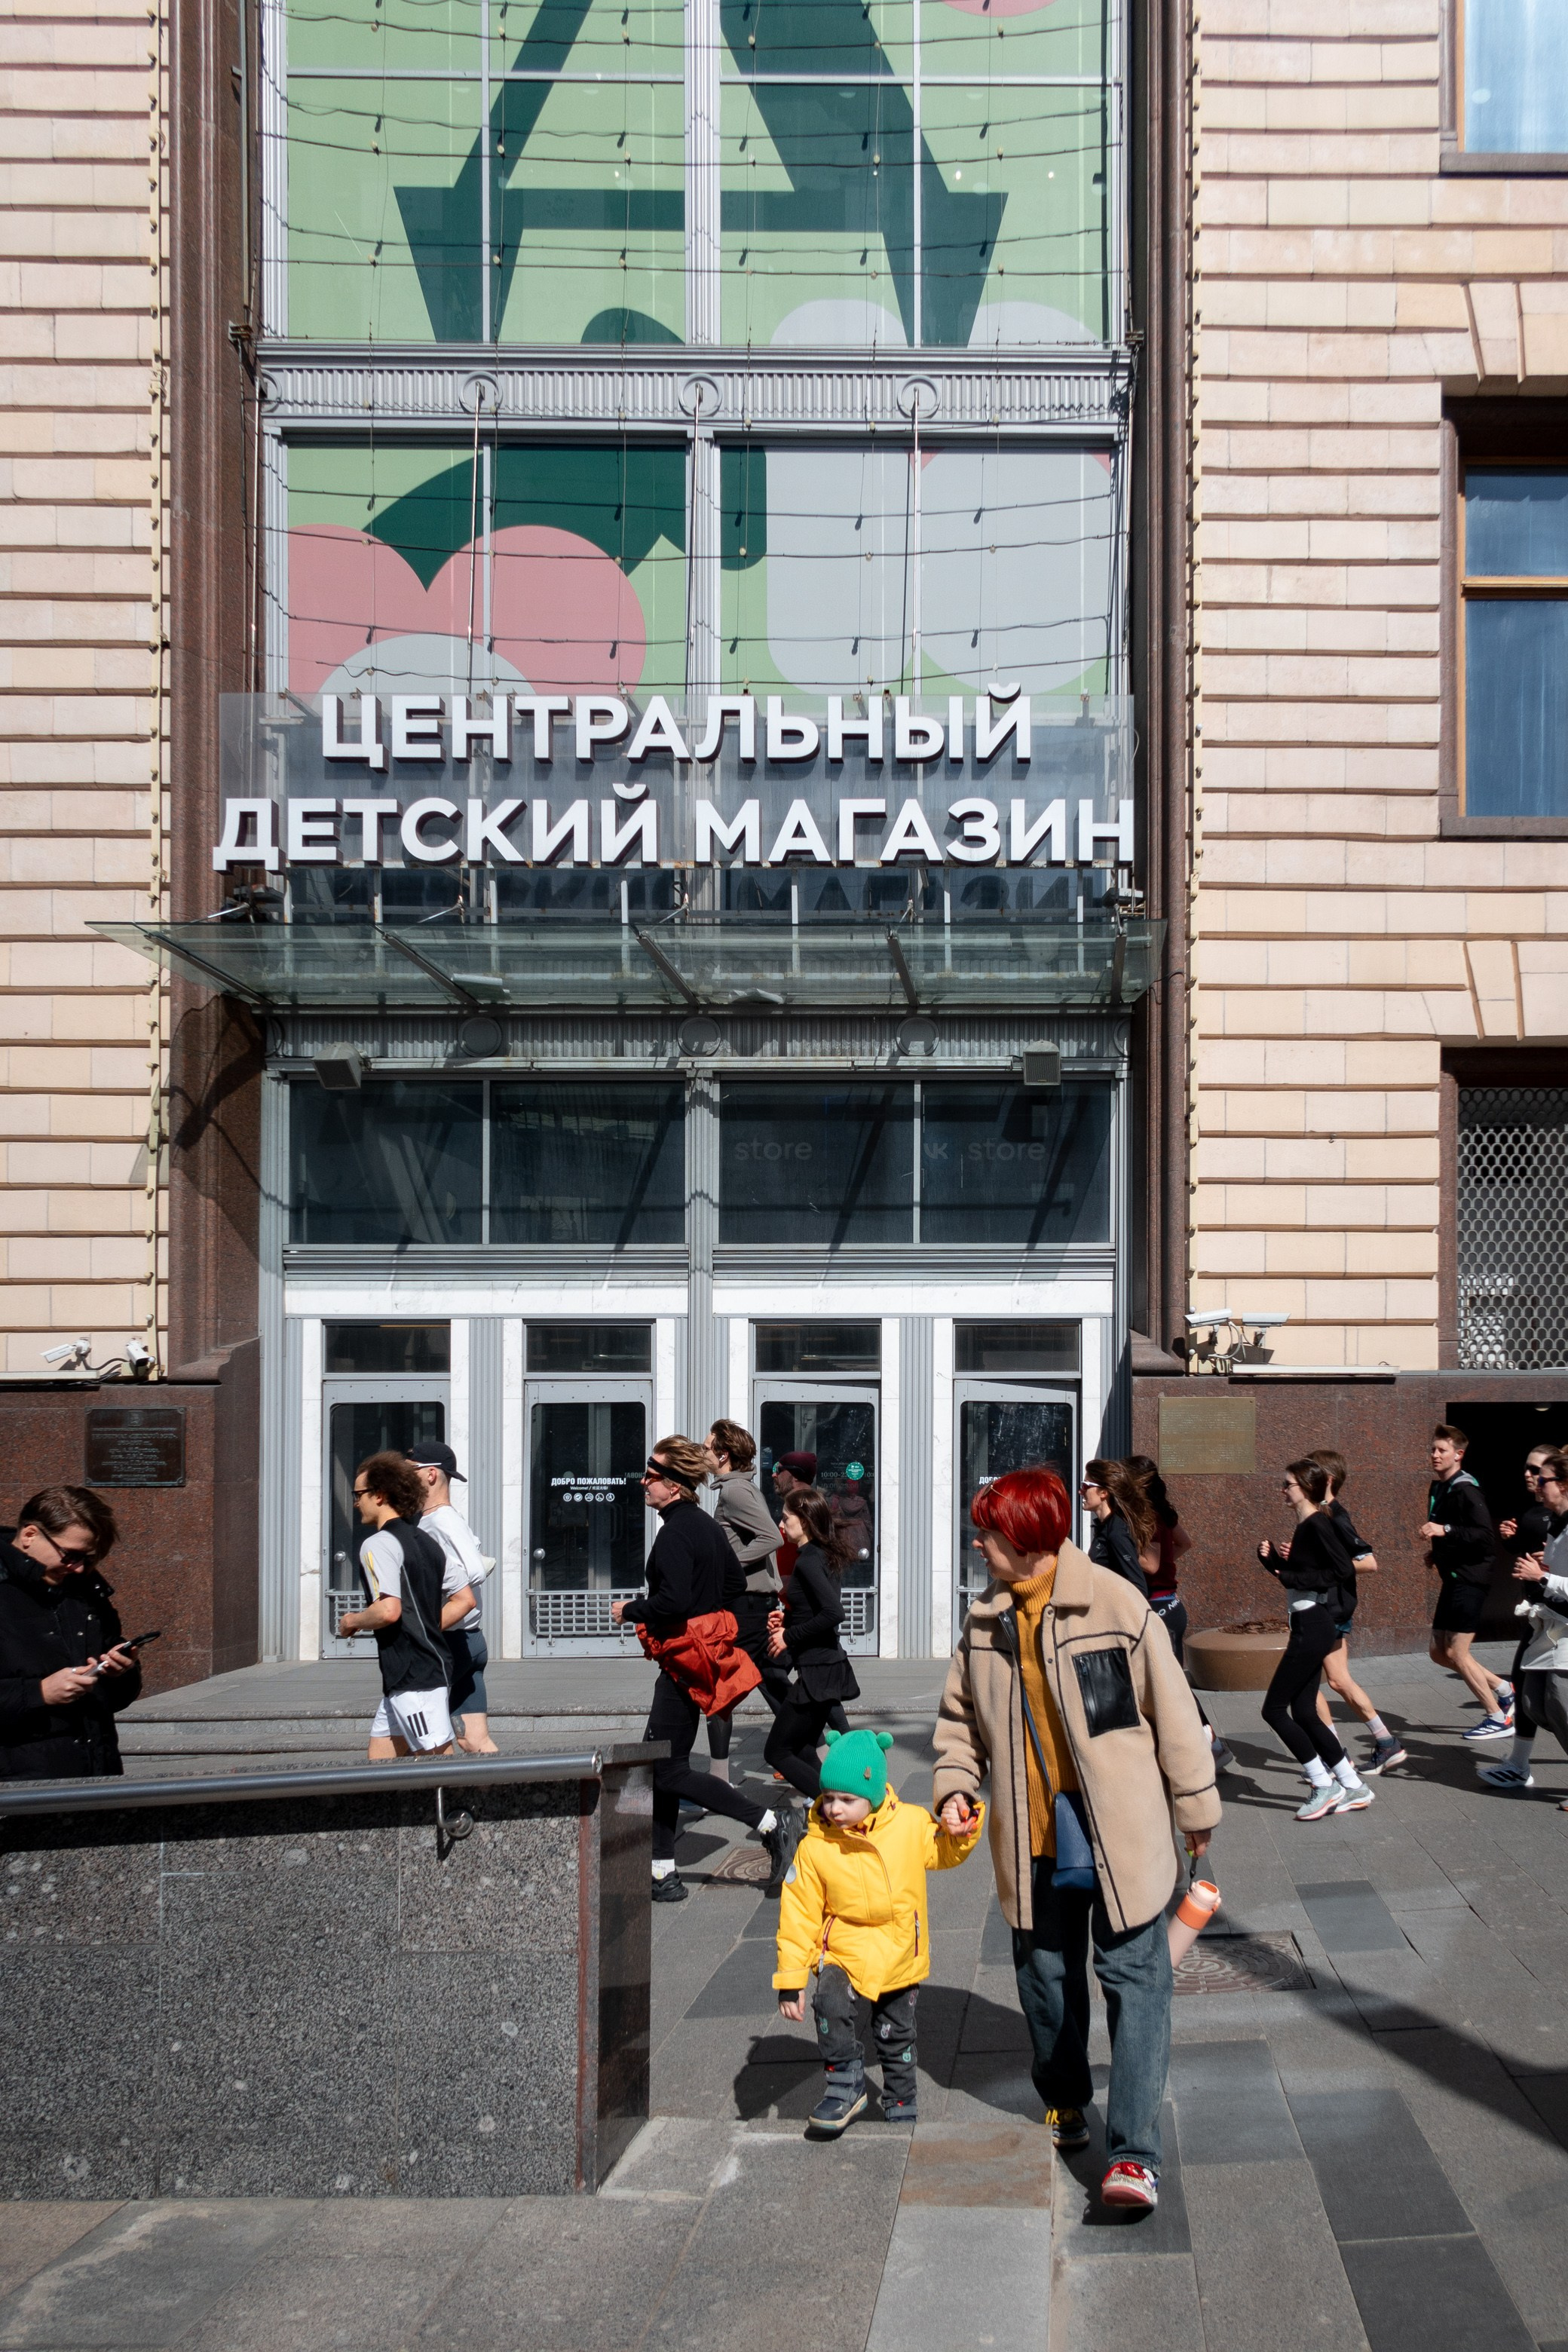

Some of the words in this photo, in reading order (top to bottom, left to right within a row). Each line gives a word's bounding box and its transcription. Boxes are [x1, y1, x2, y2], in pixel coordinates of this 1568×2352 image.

[323, 682, 1031, 770] ЦЕНТРАЛЬНЫЙ
[213, 783, 658, 871] ДЕТСКИЙ
[696, 798, 1134, 863] МАГАЗИН
[734, 1137, 813, 1161] store
[968, 1136, 1046, 1161] store
[551, 1478, 574, 1486] ДОБРО
